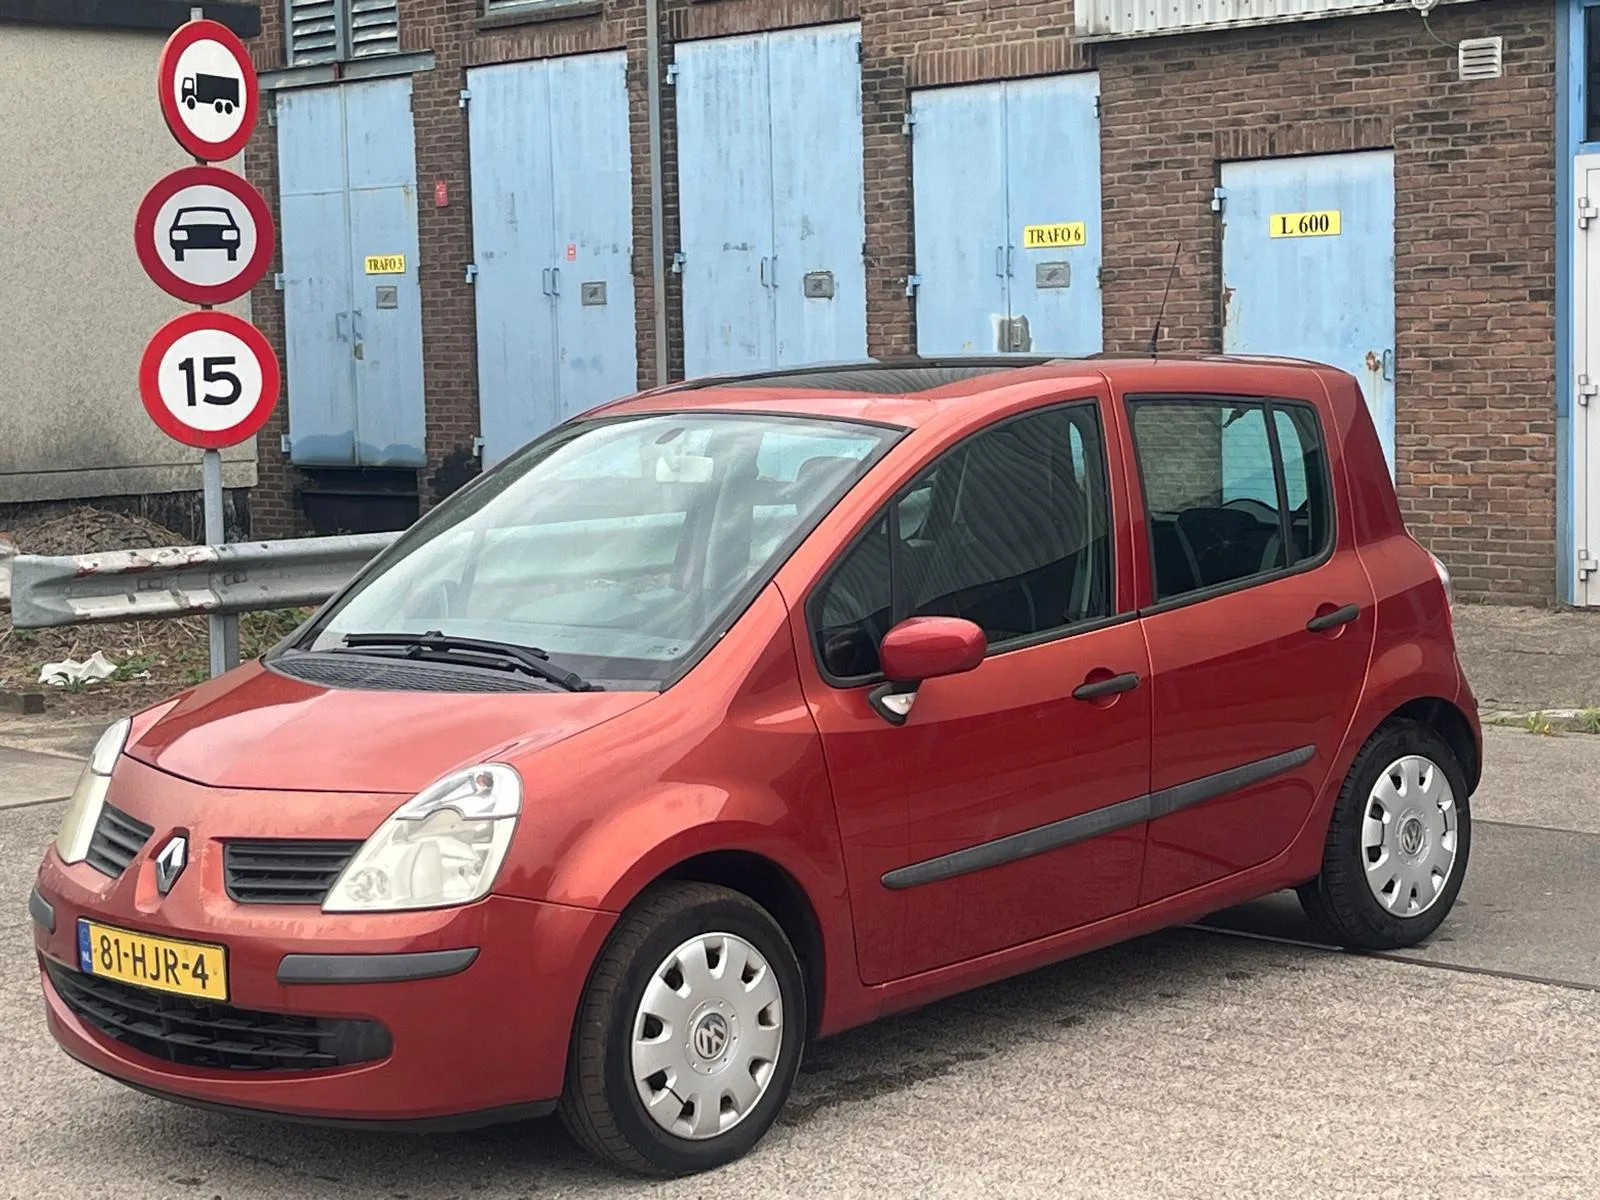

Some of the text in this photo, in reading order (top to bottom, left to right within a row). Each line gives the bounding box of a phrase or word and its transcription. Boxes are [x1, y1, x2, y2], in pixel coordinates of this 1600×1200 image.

[1281, 214, 1329, 235] L 600
[1028, 227, 1081, 244] TRAFO 6
[367, 257, 396, 271] TRAFO
[178, 356, 242, 406] 15
[82, 935, 208, 989] NL 81-HJR-4
